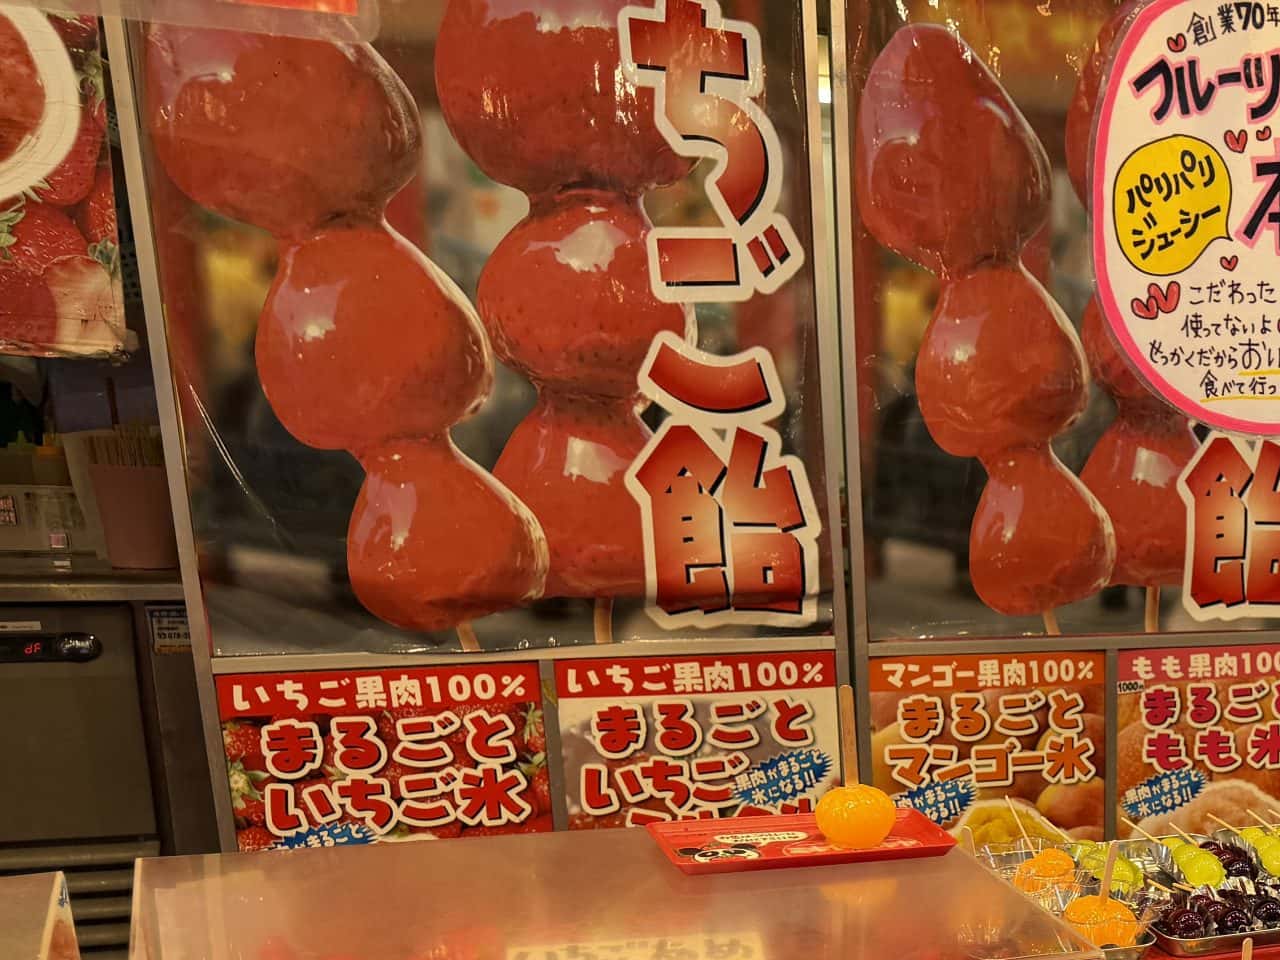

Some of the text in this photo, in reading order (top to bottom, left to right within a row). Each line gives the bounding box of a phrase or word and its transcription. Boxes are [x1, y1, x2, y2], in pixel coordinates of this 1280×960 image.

[1186, 1, 1280, 46] 創業70年
[1126, 150, 1216, 214] パリパリ
[1131, 204, 1221, 260] ジューシー
[1181, 313, 1272, 338] 使ってないよ
[232, 673, 527, 712] いちご果肉100%
[566, 660, 824, 697] いちご果肉100%
[882, 659, 1095, 689] マンゴー果肉100%
[595, 698, 814, 757] まるごと
[901, 691, 1085, 741] まるごと
[263, 710, 516, 779] まるごと
[889, 736, 1094, 787] マンゴー氷
[265, 764, 531, 835] いちご氷
[582, 752, 750, 815] いちご
